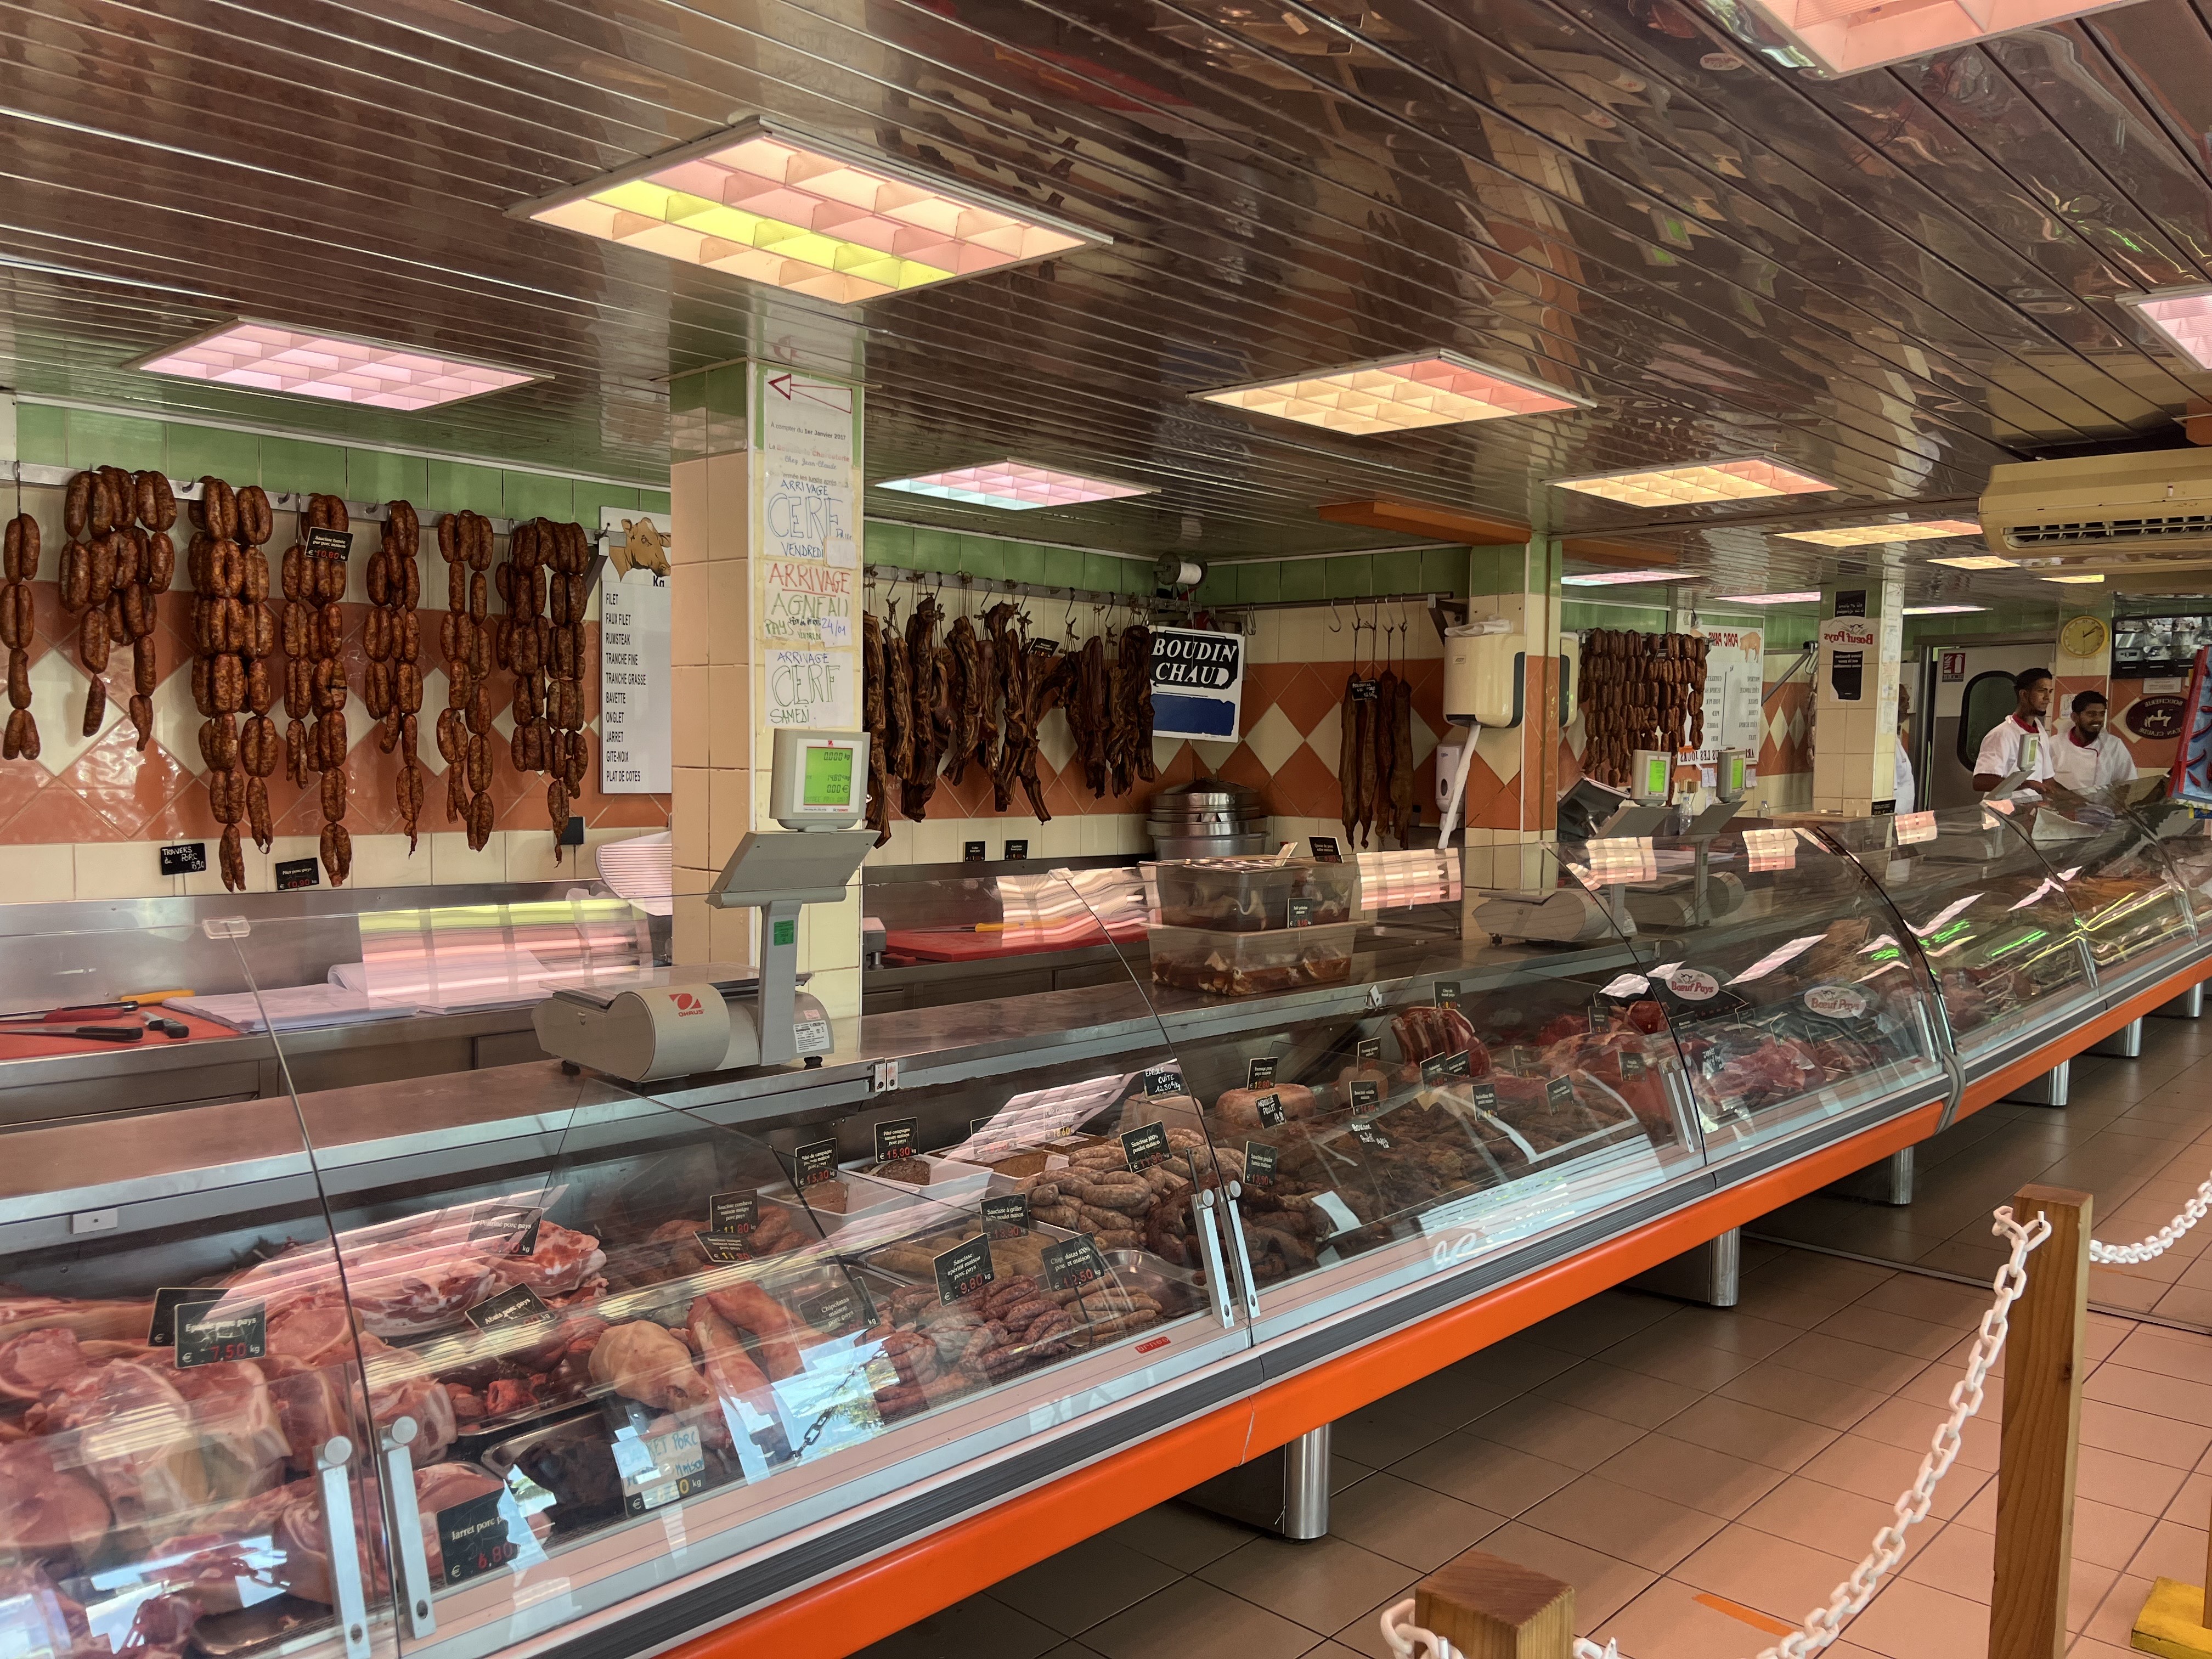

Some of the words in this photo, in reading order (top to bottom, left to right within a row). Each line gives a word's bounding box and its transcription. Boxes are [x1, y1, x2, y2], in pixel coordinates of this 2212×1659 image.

[776, 424, 795, 433] compter
[785, 455, 798, 465] Chez
[781, 479, 828, 495] ARRIVAGE
[768, 493, 843, 544] CERF
[606, 593, 618, 605] FILET
[606, 612, 618, 625] FAUX
[619, 614, 631, 625] FILET
[764, 618, 794, 636] PAYS
[606, 633, 630, 646] RUMSTEAK
[1151, 638, 1237, 663] BOUDIN
[606, 652, 627, 665] TRANCHE
[628, 653, 638, 665] FINE
[606, 672, 627, 685] TRANCHE
[628, 674, 646, 685] GRASSE
[1155, 662, 1229, 686] CHAUD
[772, 664, 840, 708] CERF
[606, 692, 626, 704] BAVETTE
[606, 712, 624, 723] ONGLET
[606, 731, 624, 743] JARRET
[606, 751, 629, 763] GITE-NOIX
[606, 770, 618, 782] PLAT
[619, 771, 625, 782] DE
[626, 771, 641, 782] COTES
[162, 846, 193, 856] TRAVERS
[1695, 981, 1713, 994] Pays
[1839, 1000, 1860, 1012] Pays
[522, 1245, 531, 1253] kg
[1078, 1246, 1091, 1255] 100%
[953, 1252, 973, 1266] Saucisse
[964, 1255, 981, 1268] maison
[1073, 1254, 1091, 1265] maison
[954, 1269, 966, 1280] porc
[965, 1265, 977, 1275] pays
[944, 1291, 951, 1301] €
[503, 1304, 517, 1317] porc
[517, 1297, 531, 1310] pays
[821, 1297, 850, 1313] Chipolatas
[828, 1305, 848, 1318] maison
[236, 1318, 257, 1328] pays
[540, 1312, 551, 1322] kg
[828, 1317, 842, 1327] porc
[841, 1310, 854, 1321] pays
[867, 1317, 877, 1325] kg
[154, 1333, 165, 1343] €
[182, 1352, 193, 1363] €
[250, 1345, 261, 1353] kg
[672, 1431, 698, 1451] PORC
[633, 1498, 642, 1510] €
[692, 1479, 702, 1488] kg
[452, 1526, 475, 1541] Jarret
[476, 1516, 496, 1533] porc
[451, 1565, 461, 1578] €
